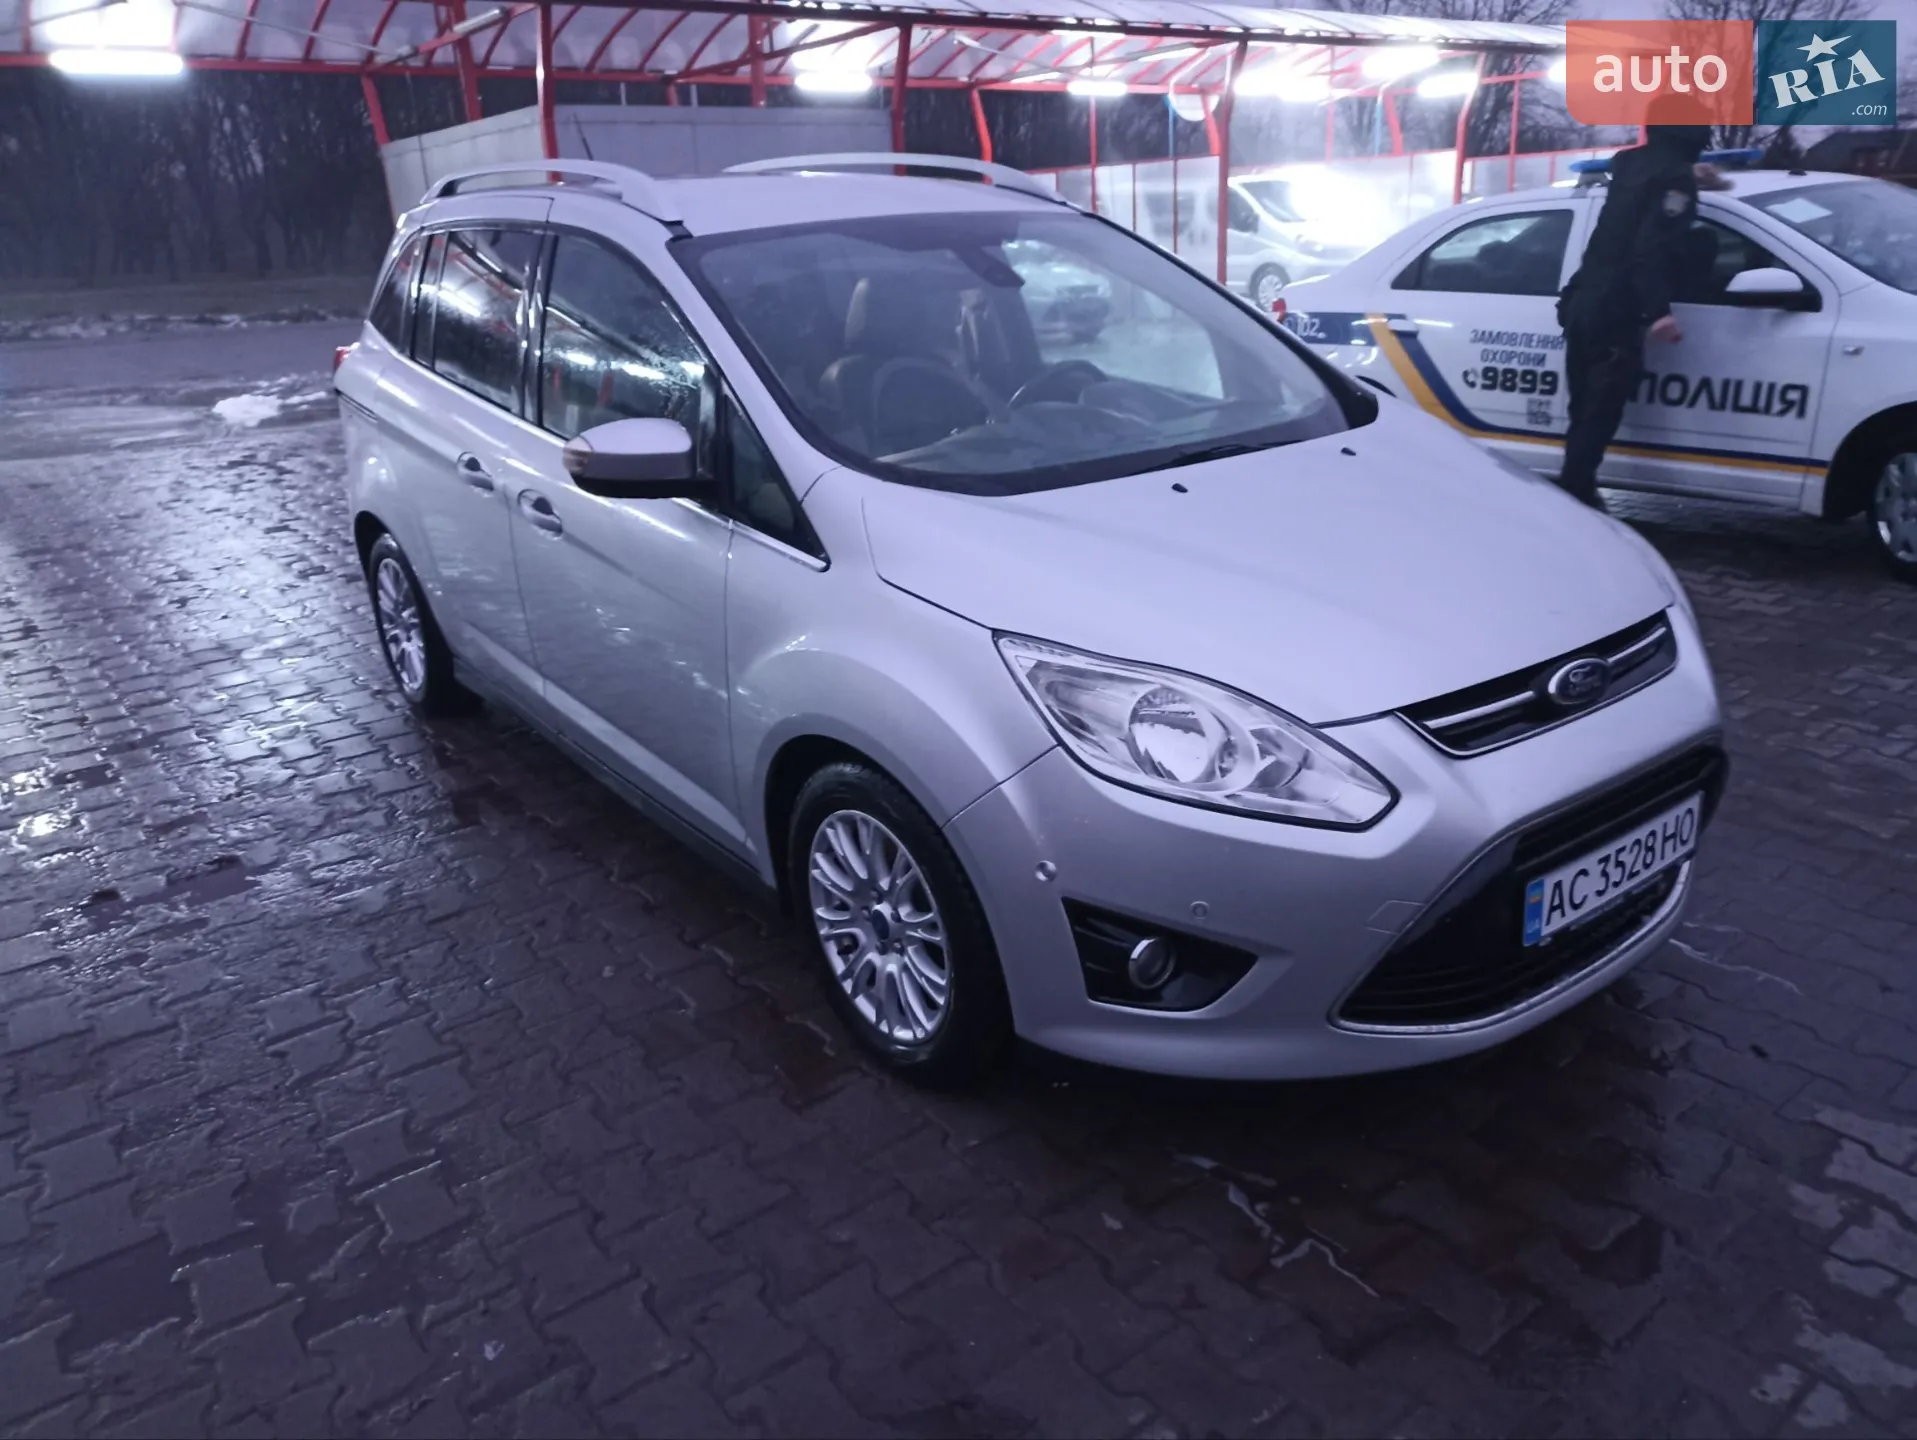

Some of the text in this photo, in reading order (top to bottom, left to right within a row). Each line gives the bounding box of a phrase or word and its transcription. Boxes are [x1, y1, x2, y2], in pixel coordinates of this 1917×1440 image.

[1480, 348, 1547, 367] ОХОРОНИ
[1480, 366, 1559, 396] 9899
[1631, 372, 1810, 420] ПОЛІЦІЯ
[1545, 807, 1695, 927] AC 3528 HO
